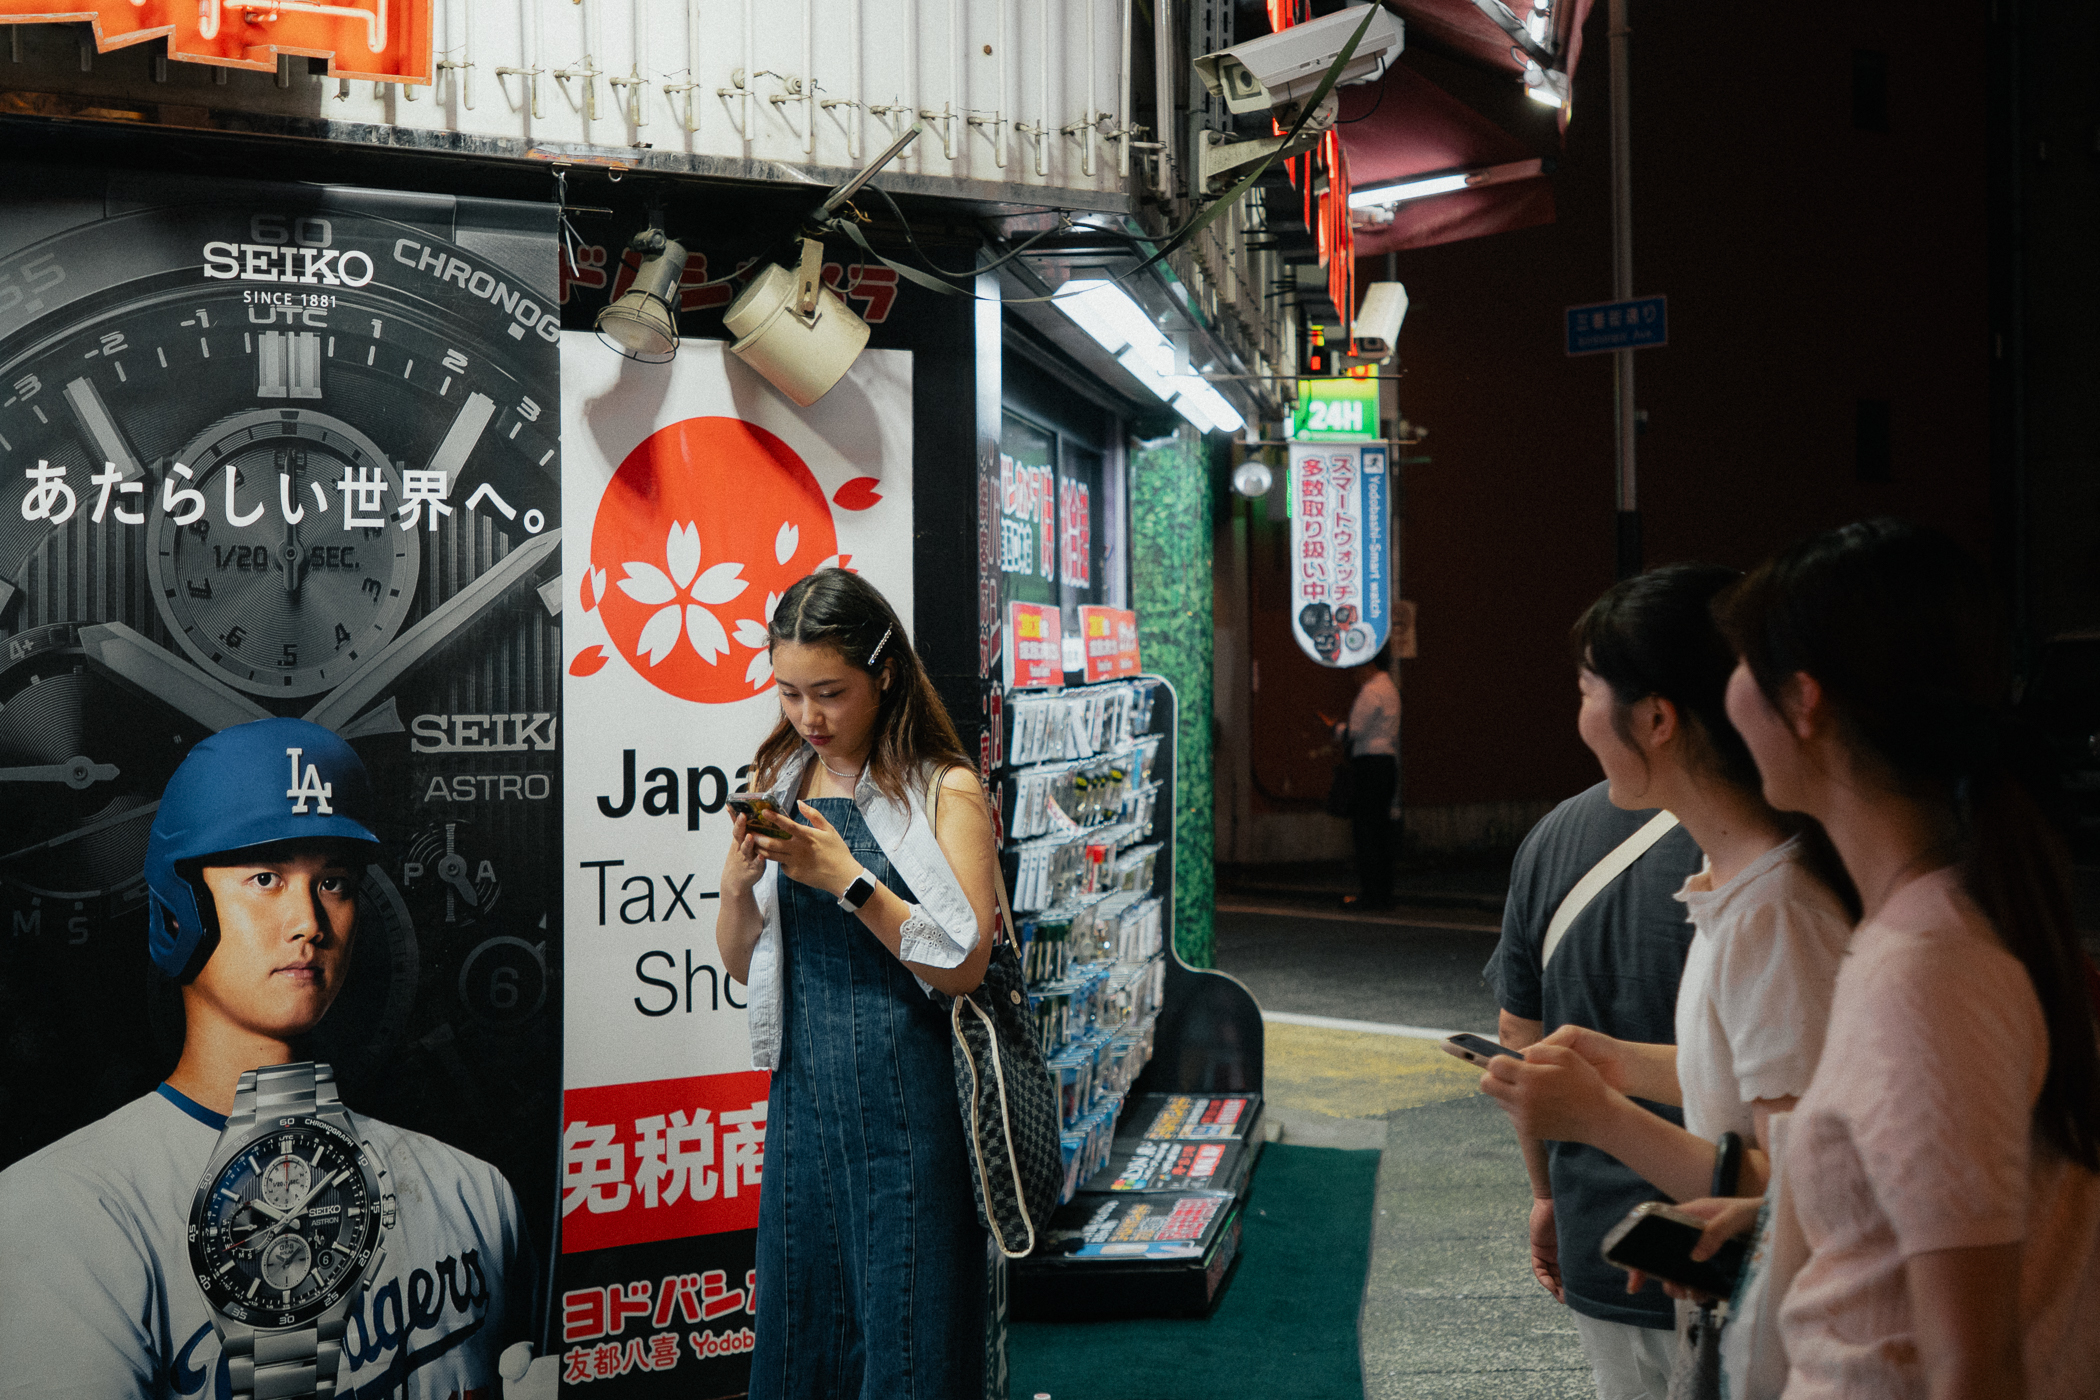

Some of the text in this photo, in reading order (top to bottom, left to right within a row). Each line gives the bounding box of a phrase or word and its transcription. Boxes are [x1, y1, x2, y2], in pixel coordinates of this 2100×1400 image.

[250, 213, 332, 248] 60
[203, 241, 374, 288] SEIKO
[243, 290, 336, 308] SINCE 1881
[248, 304, 328, 328] UTC
[371, 318, 383, 339] 1
[441, 348, 469, 375] 2
[516, 395, 542, 422] 3
[1307, 400, 1363, 431] 24H
[21, 460, 546, 533] あたらしい世界へ。
[1301, 457, 1326, 601] 多数取り扱い中
[1331, 456, 1353, 601] スマートウォッチ
[213, 545, 361, 571] 1/20 SEC.
[410, 712, 557, 753] SEIK
[286, 748, 333, 814] LA
[404, 863, 424, 886] P
[475, 859, 497, 883] A
[580, 859, 720, 926] Tax-
[12, 909, 41, 937] M
[67, 916, 89, 945] S
[489, 966, 519, 1009] 6
[279, 1117, 355, 1148] 60 CHRONOGRAPH
[358, 1154, 369, 1167] 10
[200, 1173, 213, 1190] 50
[308, 1204, 341, 1218] SEIKO
[373, 1200, 380, 1214] 15
[188, 1223, 197, 1243] 45
[311, 1216, 340, 1227] ASTRON
[322, 1255, 330, 1265] 6
[358, 1249, 371, 1267] 20
[198, 1274, 211, 1291] 40
[323, 1291, 339, 1307] 25
[563, 1269, 756, 1343] ヨドバシ
[231, 1307, 248, 1320] 35
[278, 1315, 295, 1325] 30
[563, 1332, 680, 1385] 友都八喜
